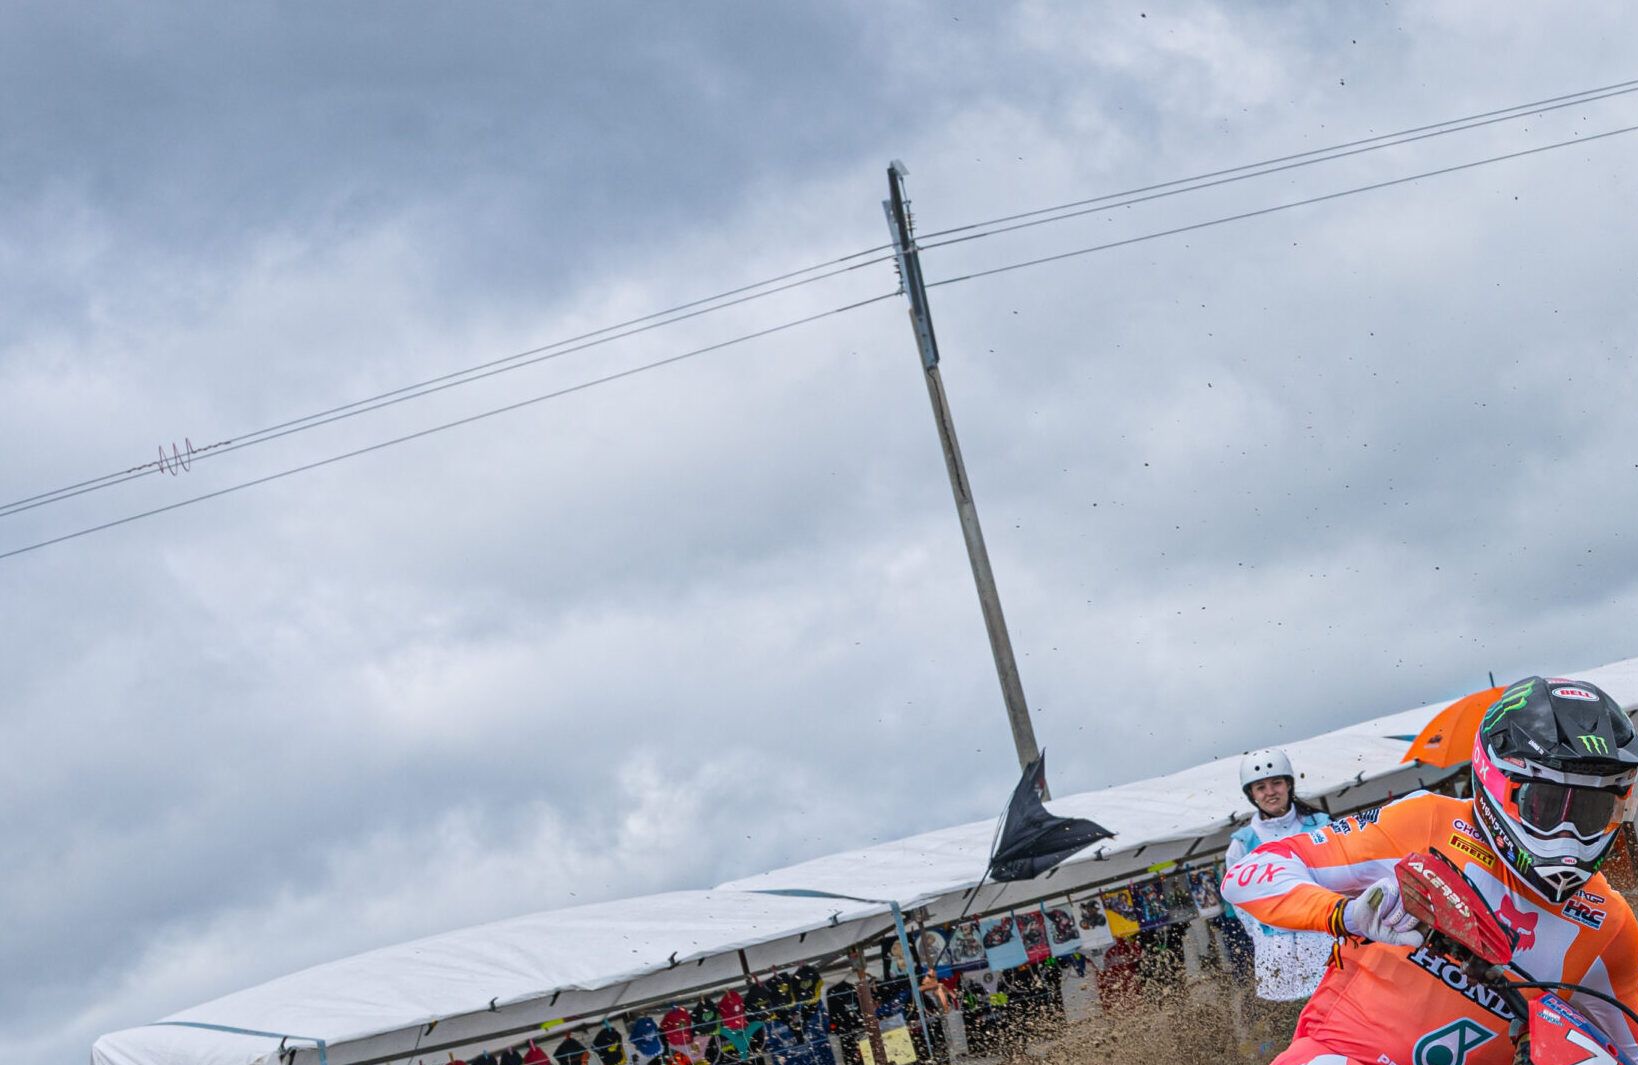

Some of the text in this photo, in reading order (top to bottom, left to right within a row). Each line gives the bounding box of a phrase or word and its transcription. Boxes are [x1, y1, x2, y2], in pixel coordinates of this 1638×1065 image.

[1560, 689, 1594, 699] BELL
[1479, 796, 1516, 852] MONSTER
[1451, 836, 1494, 867] PIRELLI
[1221, 863, 1286, 891] FOX
[1408, 862, 1470, 918] ACERBIS
[1563, 900, 1606, 924] HRC
[1410, 948, 1516, 1020] HOND
